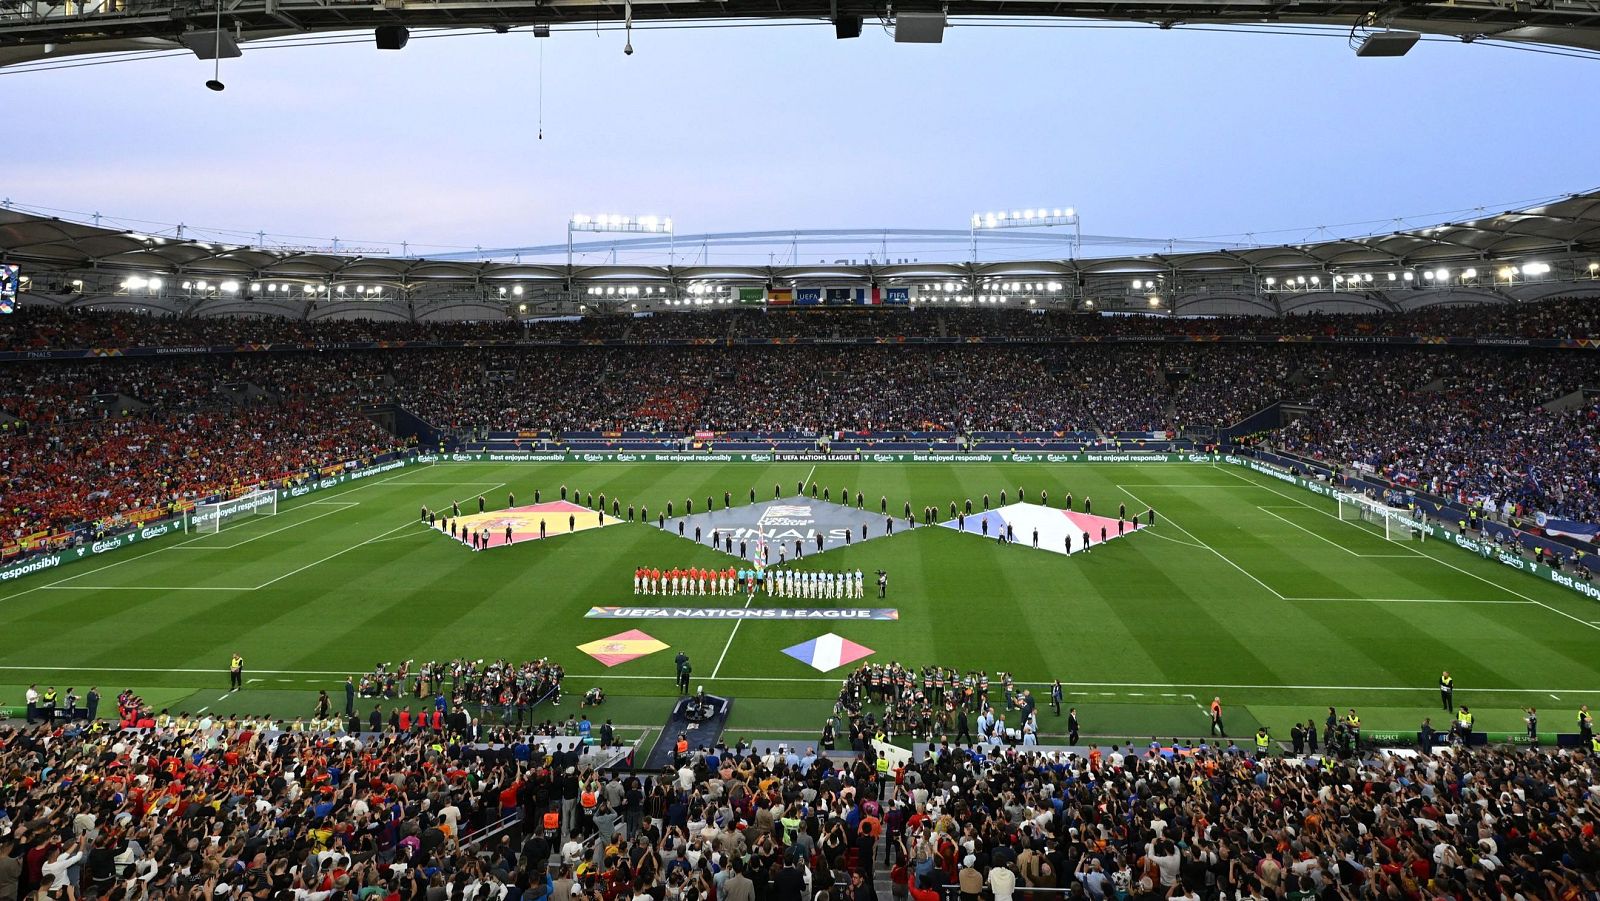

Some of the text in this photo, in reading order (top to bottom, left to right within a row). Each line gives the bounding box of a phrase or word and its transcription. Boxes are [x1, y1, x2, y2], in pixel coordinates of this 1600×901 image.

[27, 351, 52, 359] FINALS
[452, 453, 472, 462] Carlsberg
[504, 454, 529, 462] enjoyed
[529, 454, 565, 462] responsibly
[583, 453, 604, 462] Carlsberg
[617, 453, 637, 462] Carlsberg
[671, 454, 695, 462] enjoyed
[695, 454, 732, 462] responsibly
[751, 453, 771, 462] Carlsberg
[873, 453, 894, 462] Carlsberg
[928, 454, 954, 462] enjoyed
[954, 454, 992, 462] responsibly
[1012, 453, 1033, 462] Carlsberg
[1047, 453, 1068, 462] Carlsberg
[1103, 454, 1129, 462] enjoyed
[1129, 454, 1169, 462] responsibly
[1188, 453, 1210, 462] Carlsberg
[0, 555, 60, 580] responsibly
[92, 537, 121, 553] Carlsberg
[142, 524, 168, 540] Carlsberg
[191, 512, 209, 525] Best
[238, 495, 274, 511] responsibly
[291, 484, 310, 497] Carlsberg
[320, 477, 337, 488] Carlsberg
[351, 469, 363, 480] Best
[362, 466, 381, 477] enjoyed
[380, 460, 405, 473] responsibly
[417, 454, 439, 463] Carlsberg
[1225, 455, 1242, 465] Carlsberg
[1308, 481, 1323, 494] Carlsberg
[1455, 534, 1480, 552] Carlsberg
[1551, 569, 1573, 588] Best
[706, 527, 852, 539] FINALS
[613, 608, 872, 618] UEFA NATIONS LEAGUE
